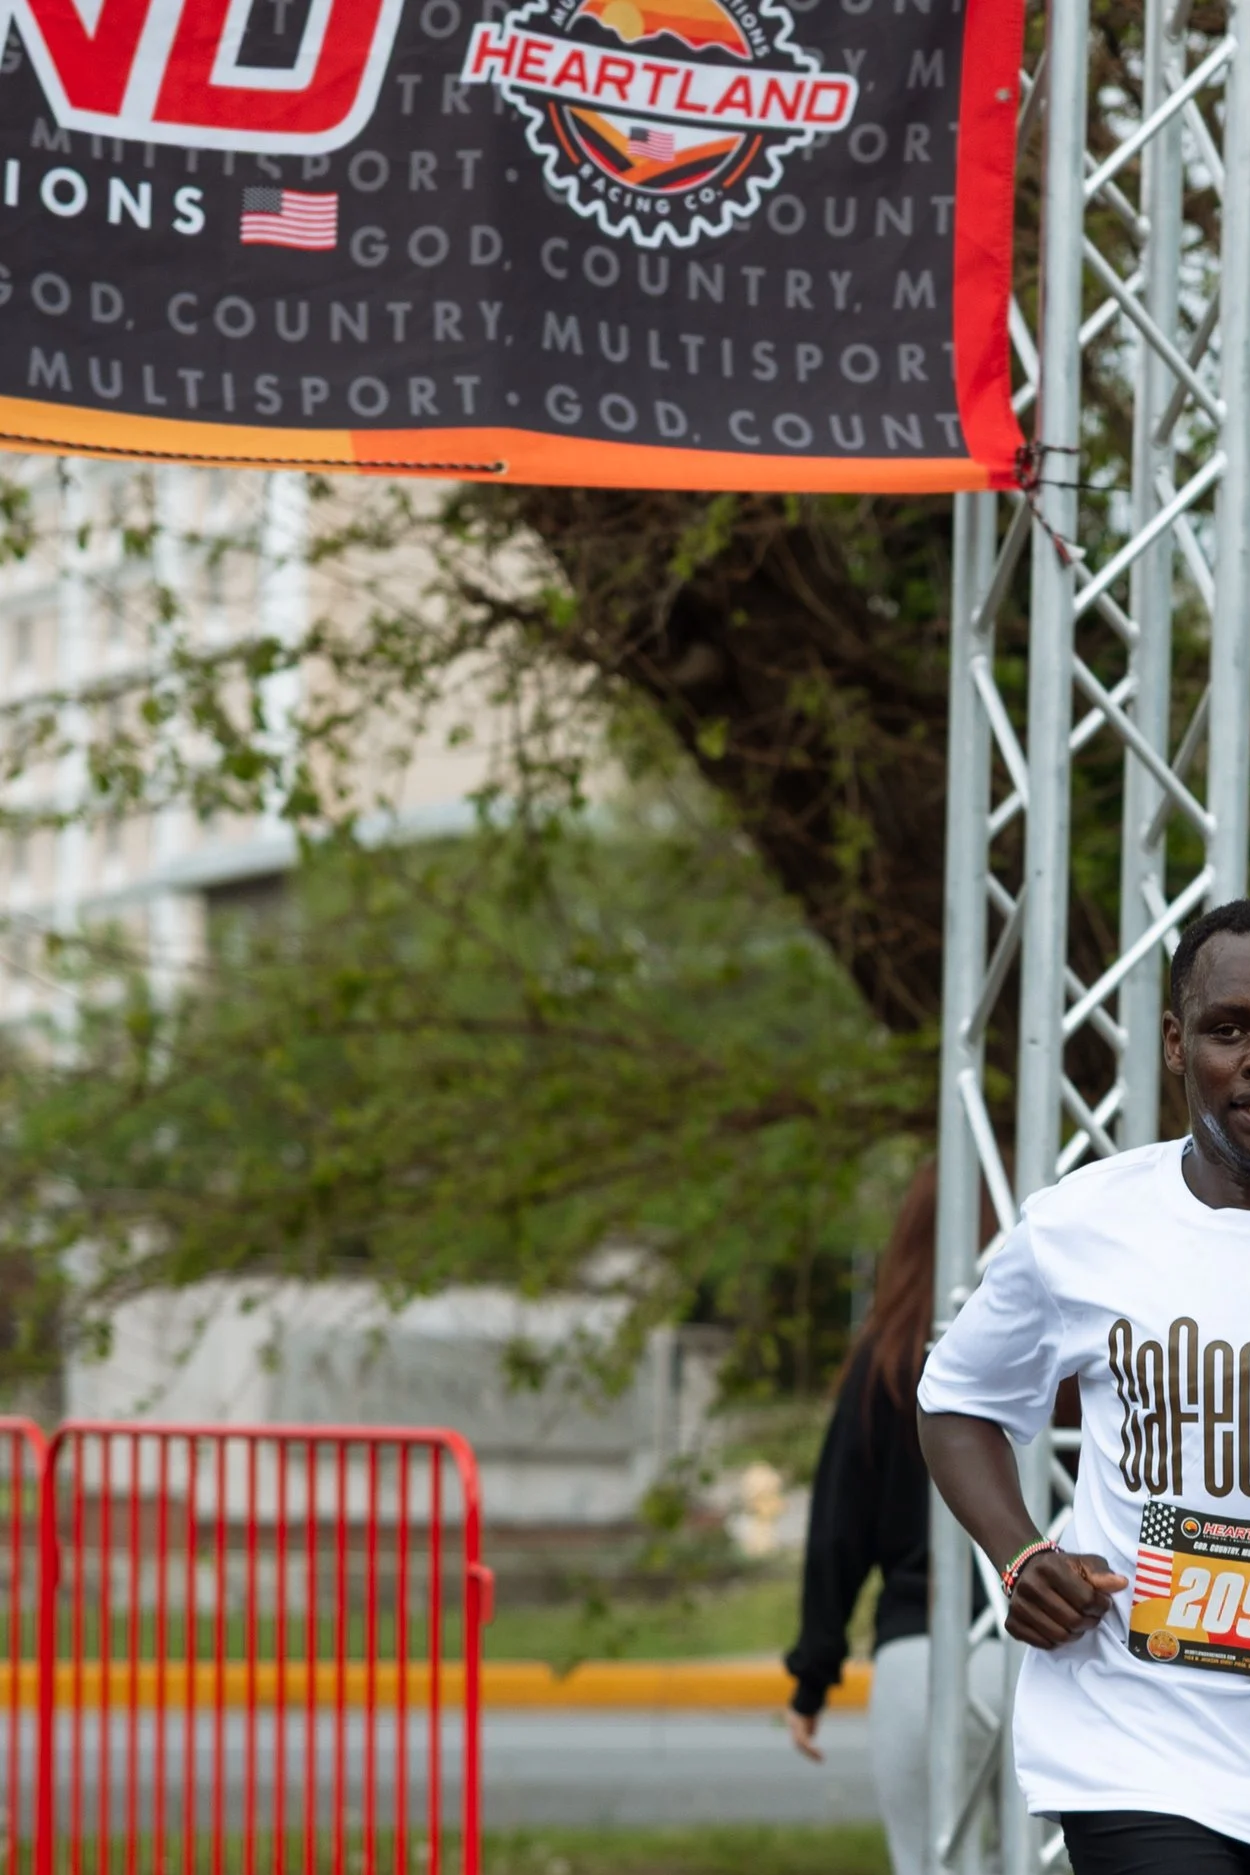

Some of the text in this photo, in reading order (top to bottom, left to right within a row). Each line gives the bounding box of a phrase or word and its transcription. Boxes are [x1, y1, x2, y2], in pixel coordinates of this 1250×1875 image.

[471, 30, 850, 124] HEARTLAND
[4, 158, 206, 236] IONS
[579, 162, 672, 214] RACING
[351, 225, 513, 271] GOD,
[541, 237, 862, 313] COUNTRY,
[167, 292, 514, 346] COUNTRY,
[27, 346, 961, 451] MULTISPORT GOD, COUNT
